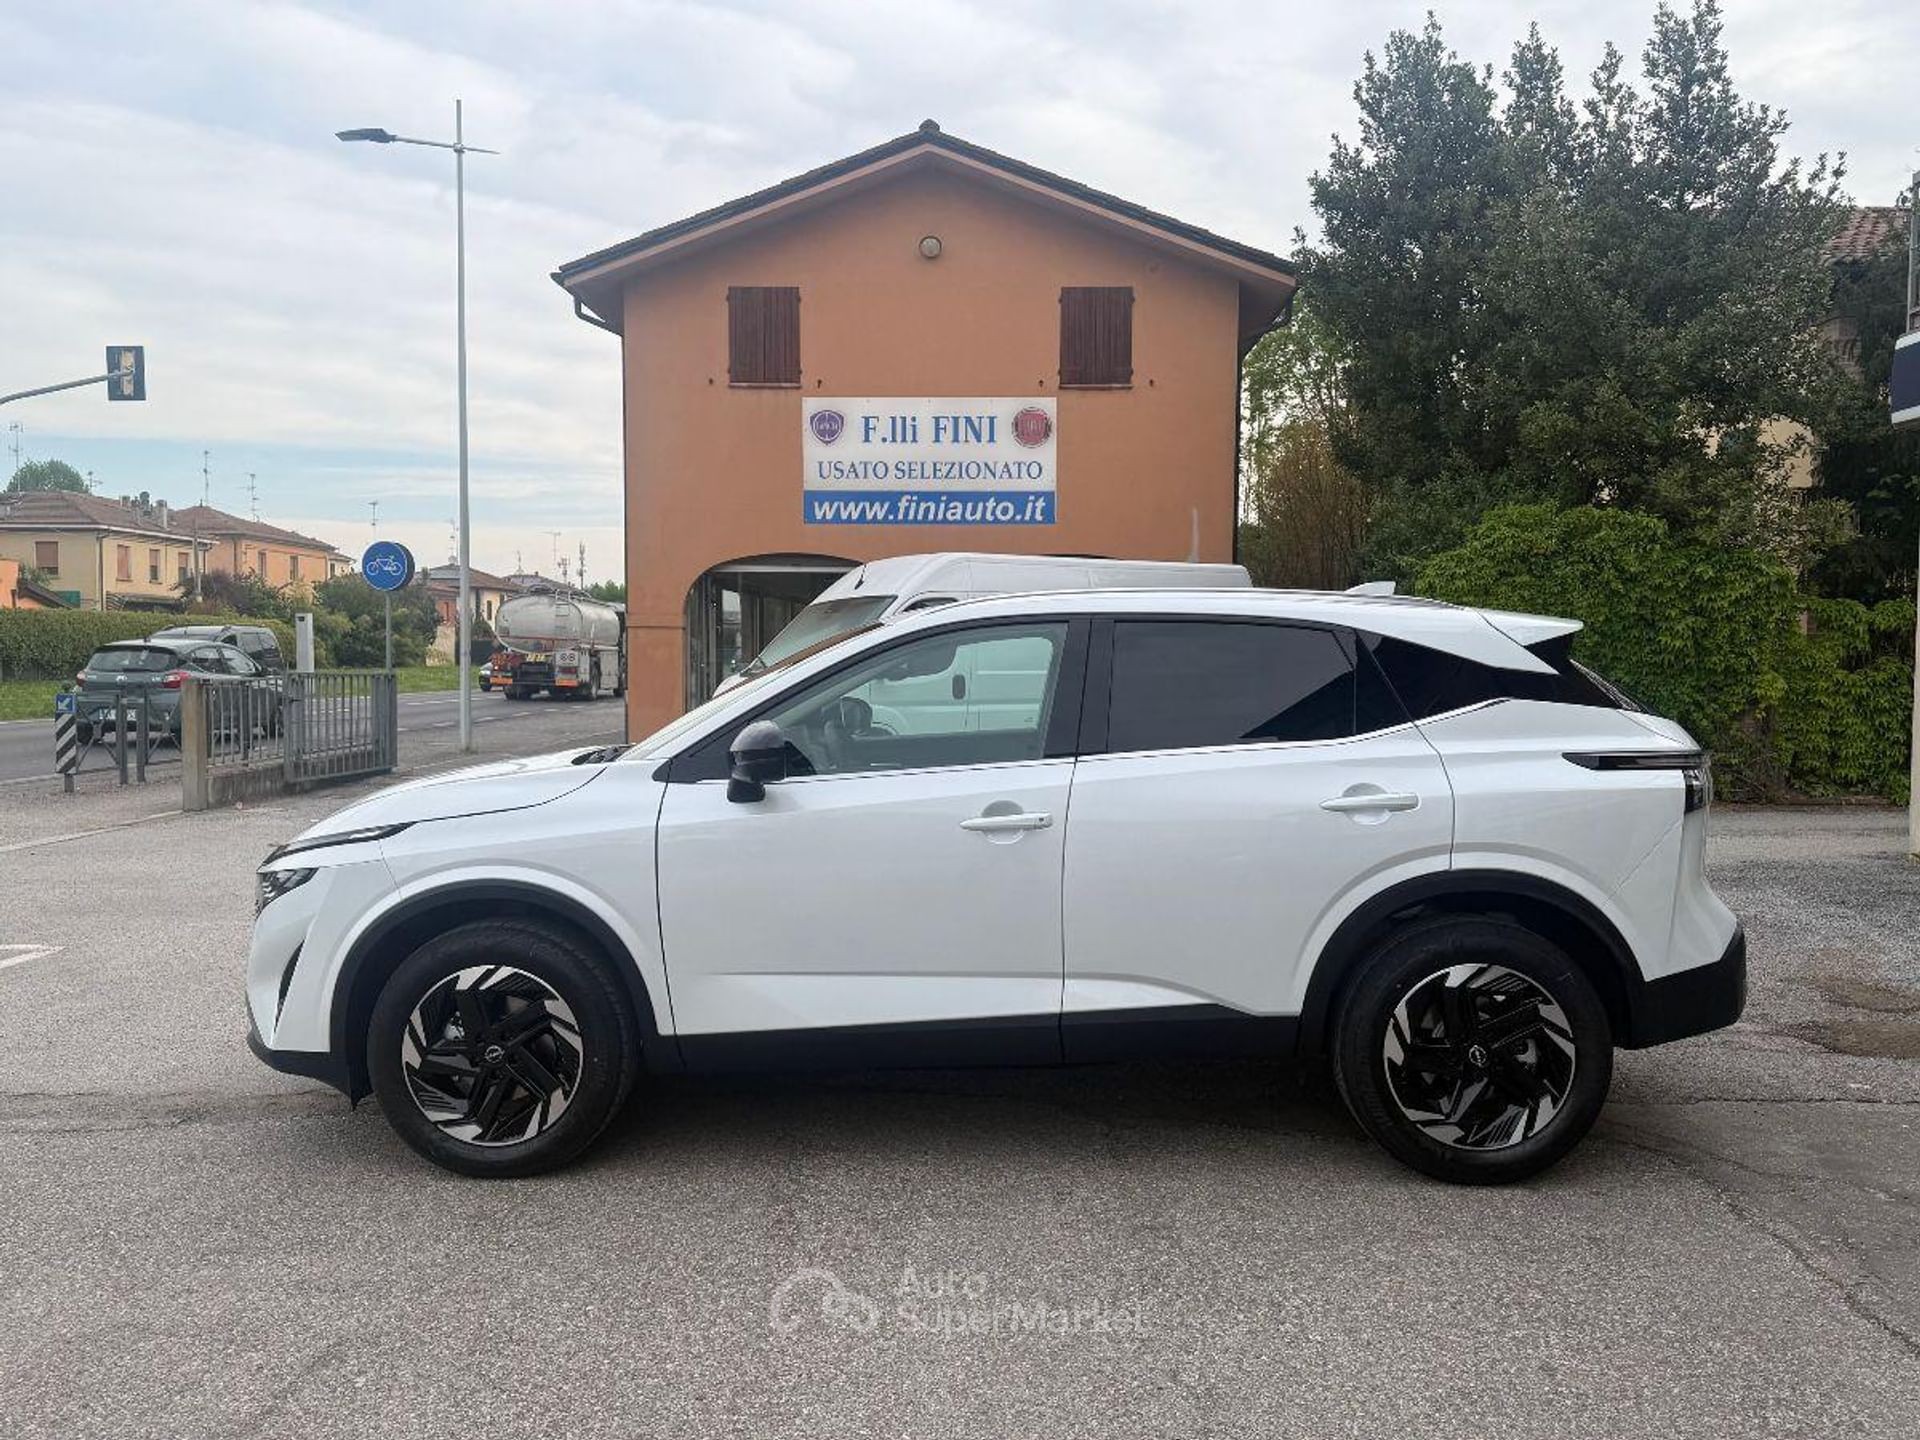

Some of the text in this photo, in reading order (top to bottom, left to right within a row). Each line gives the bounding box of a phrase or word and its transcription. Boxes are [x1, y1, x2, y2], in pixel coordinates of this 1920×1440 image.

[861, 415, 919, 444] F.lli
[932, 415, 998, 444] FINI
[817, 460, 1044, 481] USATO SELEZIONATO
[813, 494, 1047, 522] www.finiauto.it
